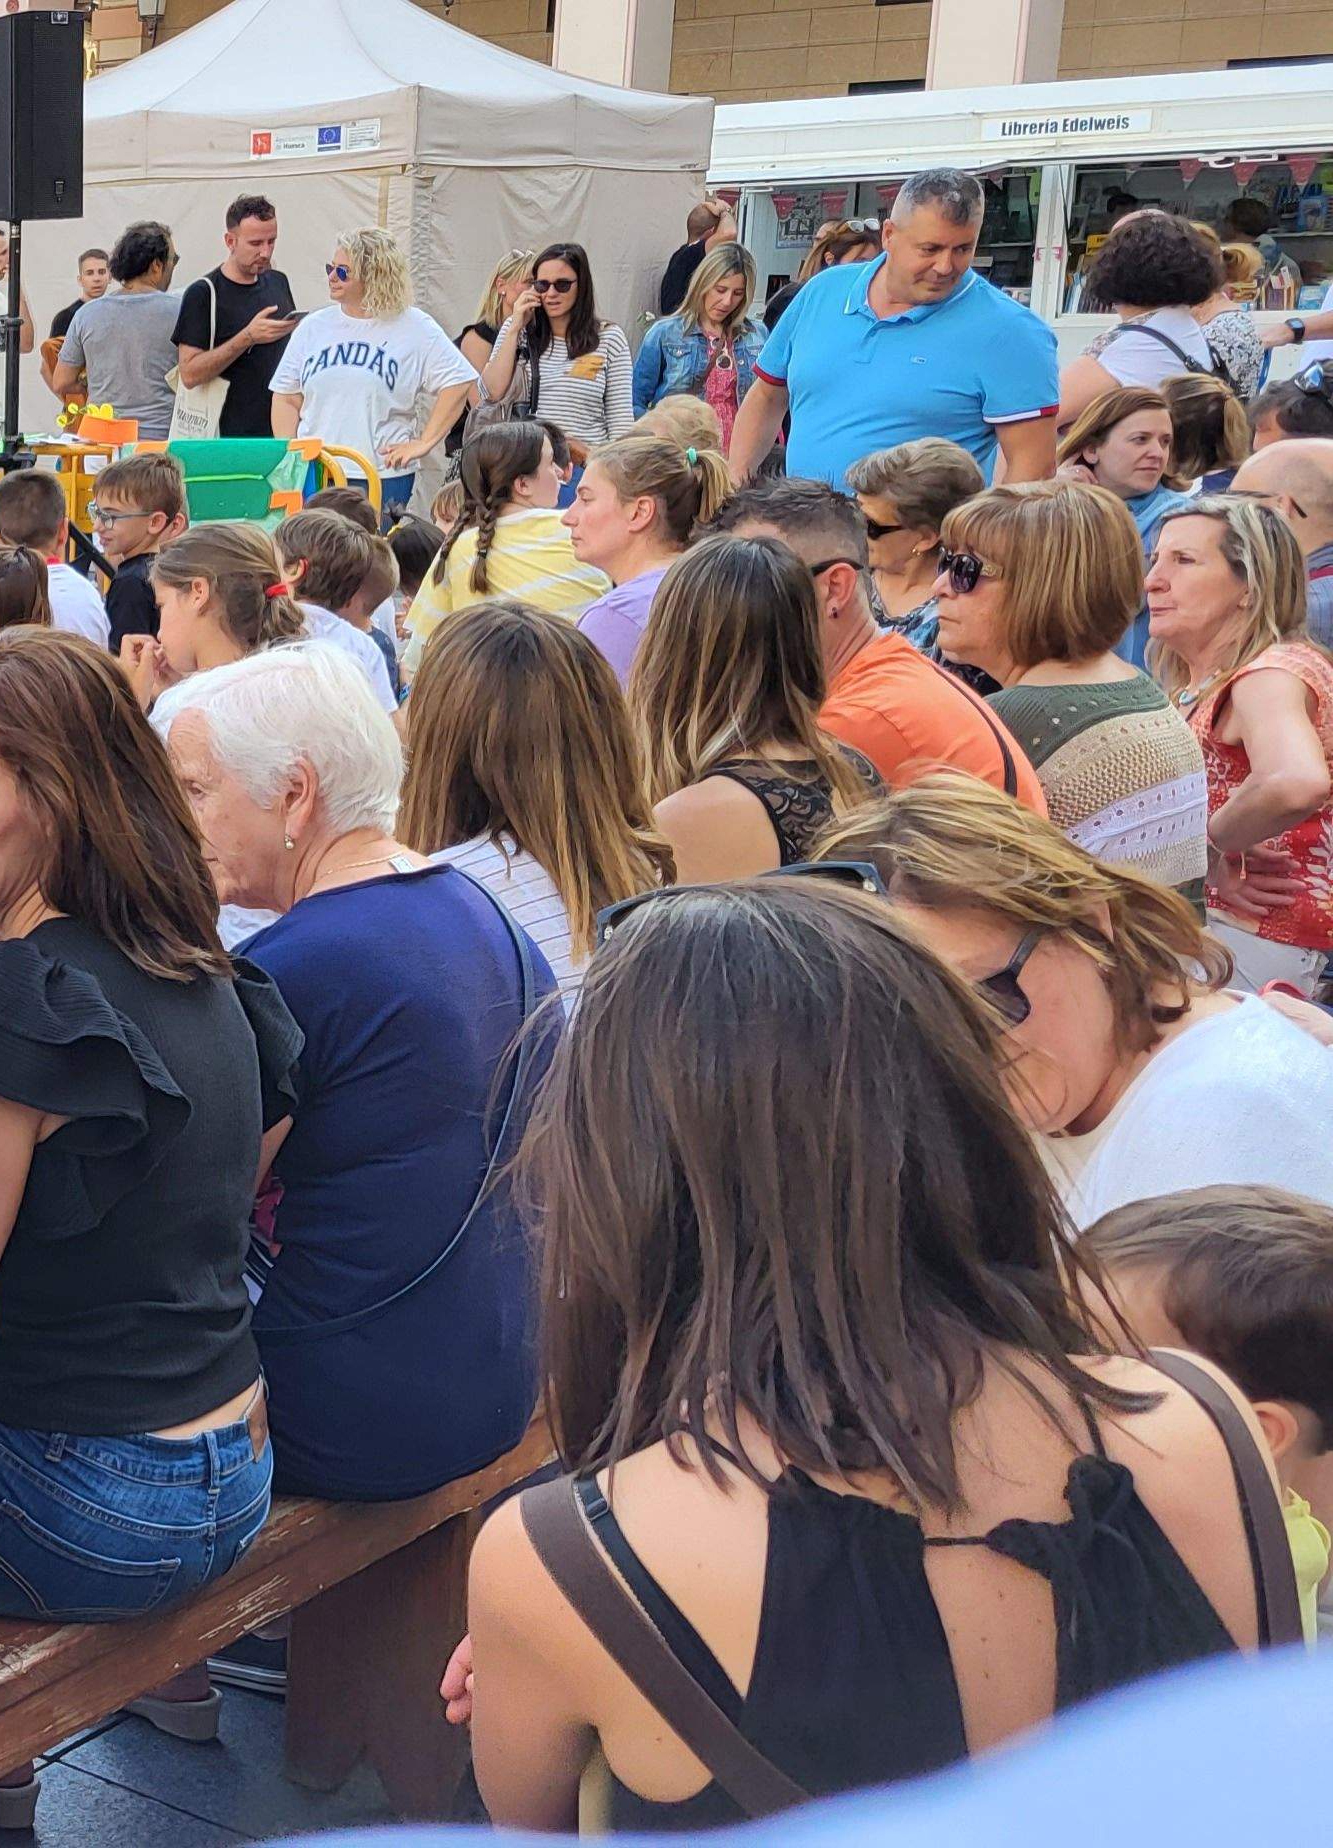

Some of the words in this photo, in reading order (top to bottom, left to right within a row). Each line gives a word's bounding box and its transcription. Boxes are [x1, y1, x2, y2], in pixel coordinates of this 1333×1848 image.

[1001, 118, 1059, 136] Librería
[1062, 115, 1130, 133] Edelweis
[301, 341, 398, 392] CANDÁS
